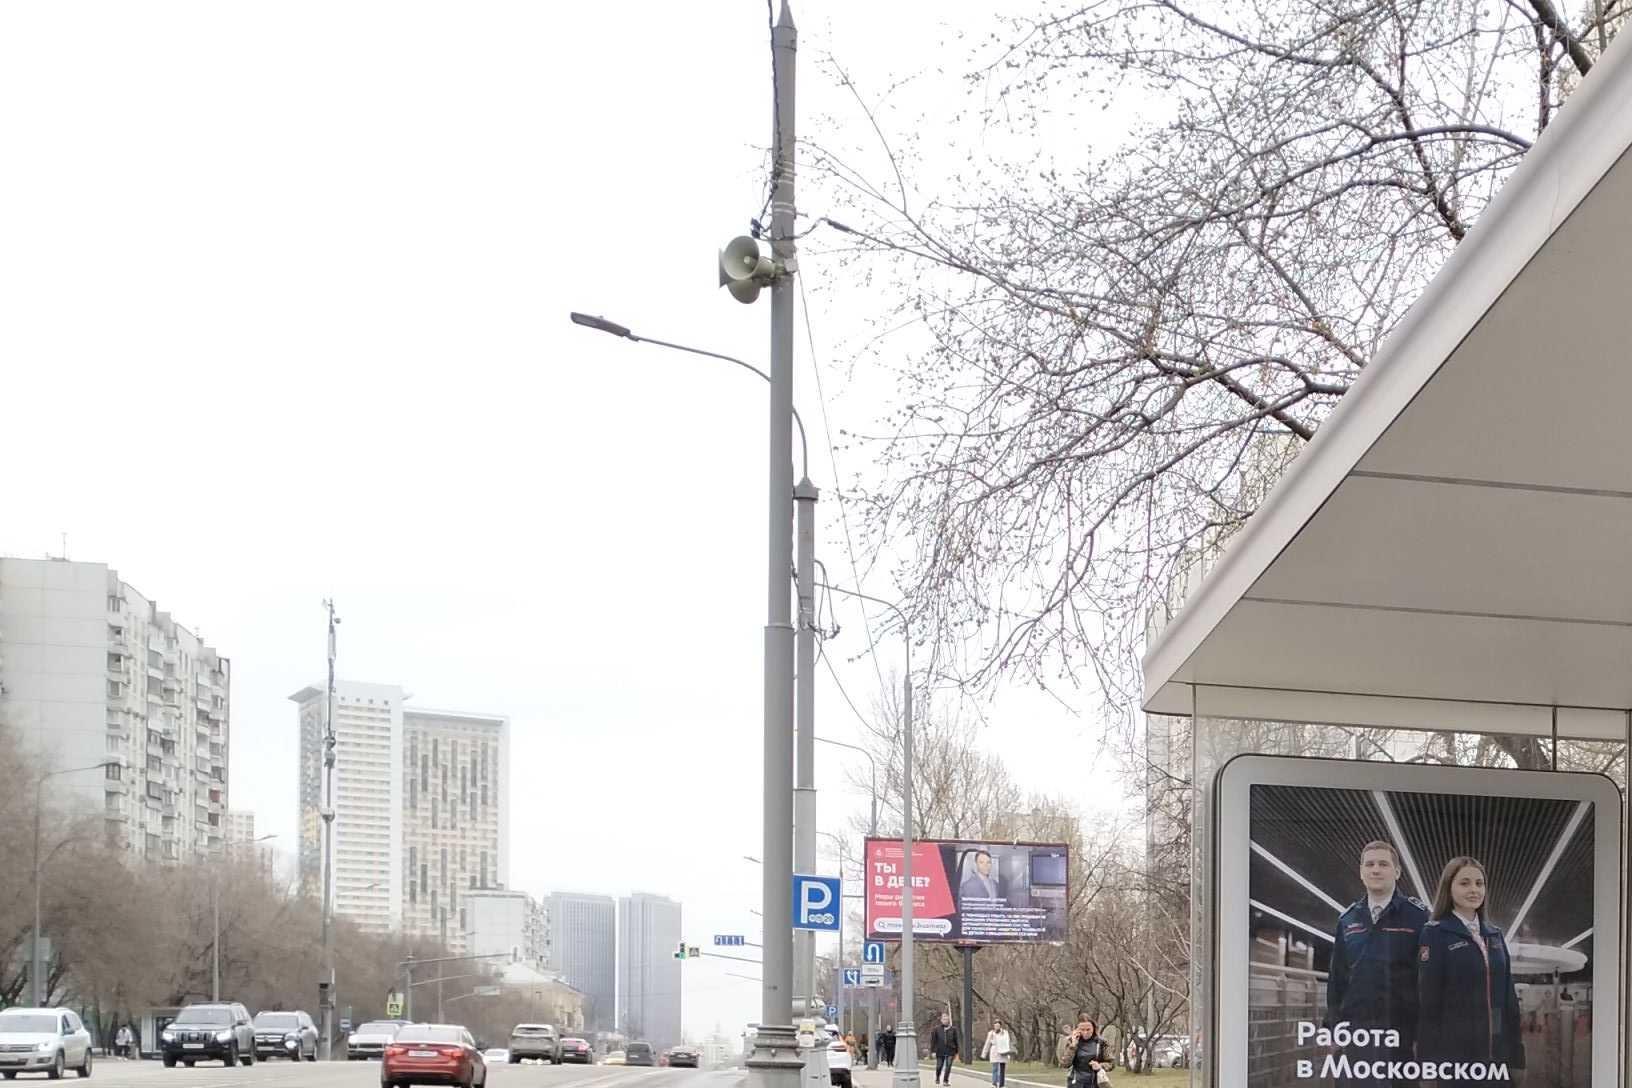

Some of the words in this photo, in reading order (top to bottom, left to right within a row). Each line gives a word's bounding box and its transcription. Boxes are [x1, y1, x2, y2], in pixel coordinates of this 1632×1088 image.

[874, 862, 896, 873] ТЫ
[874, 875, 884, 886] В
[1297, 1021, 1400, 1048] Работа
[1296, 1059, 1313, 1078] в
[1320, 1054, 1510, 1081] Московском
